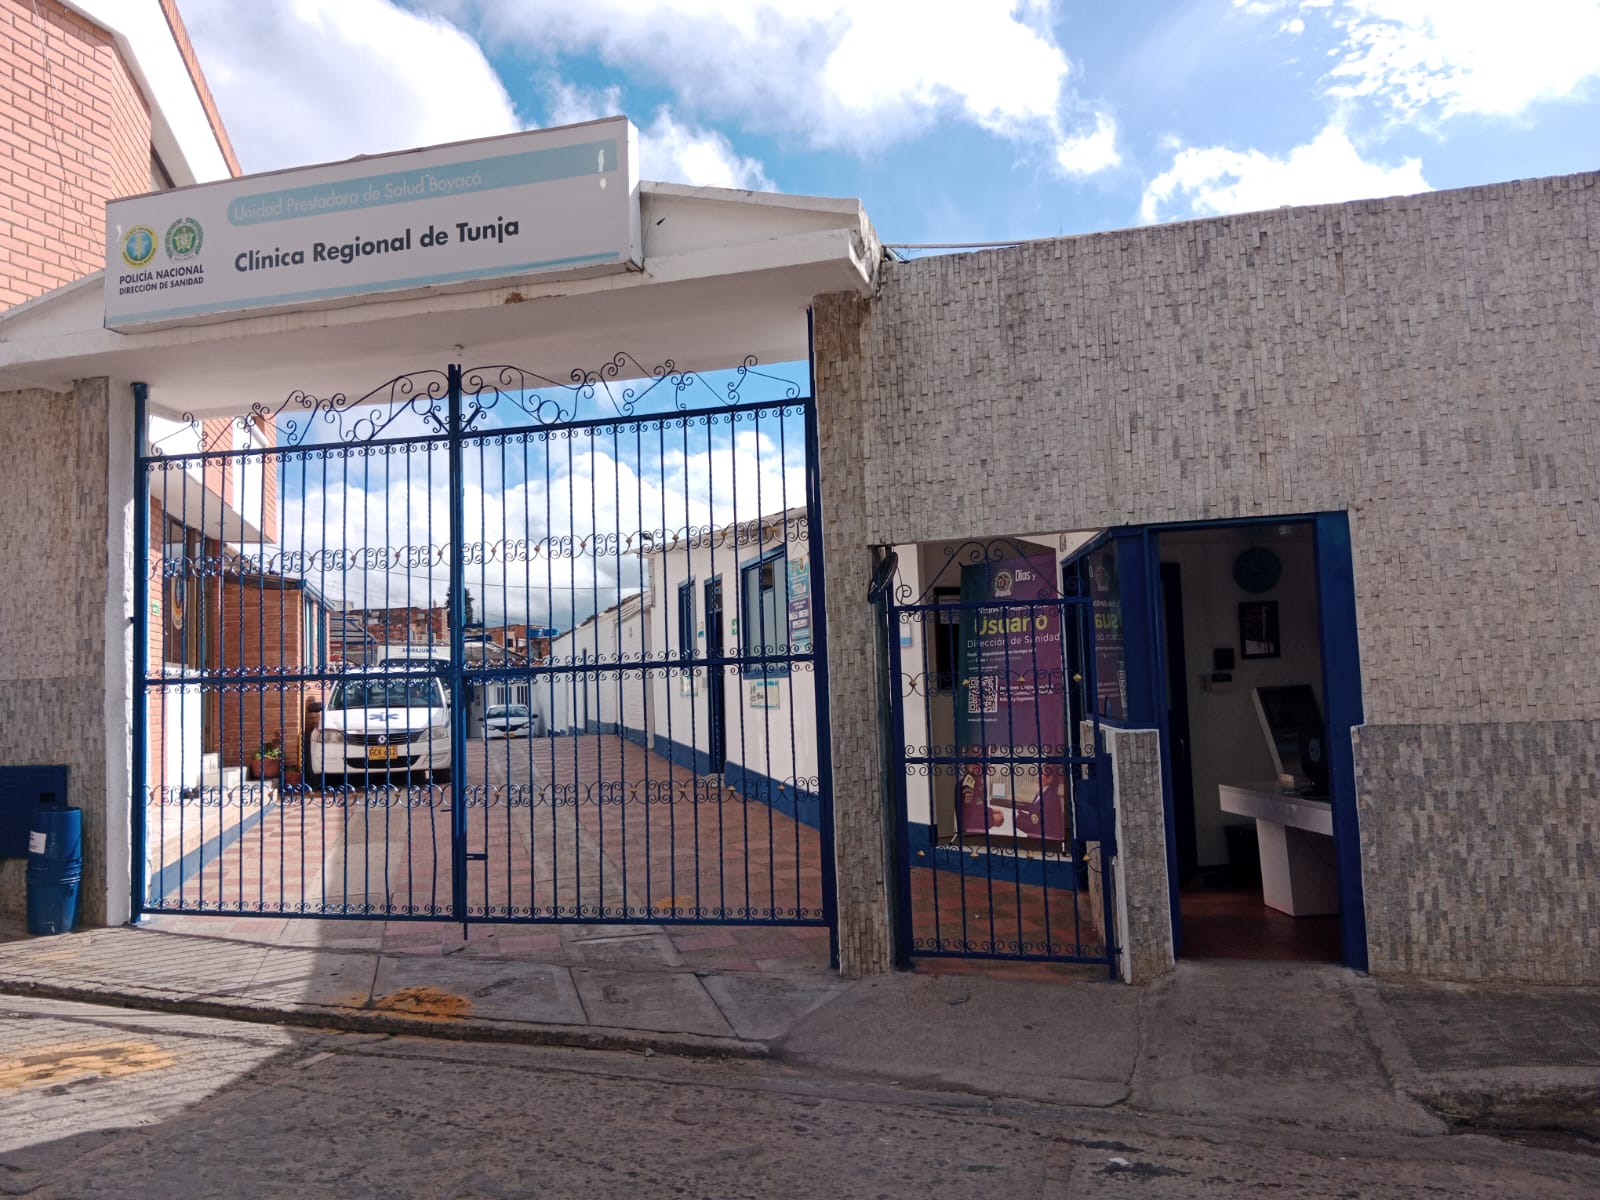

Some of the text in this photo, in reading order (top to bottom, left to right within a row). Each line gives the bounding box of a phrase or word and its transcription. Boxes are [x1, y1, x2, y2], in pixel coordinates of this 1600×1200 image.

[234, 170, 482, 220] Unidad Prestadora de Salud Boyacá
[234, 215, 519, 272] Clínica Regional de Tunja
[119, 264, 204, 285] POLICÍA NACIONAL
[160, 281, 168, 290] DE
[170, 277, 204, 288] SANIDAD
[974, 614, 1048, 636] Usuaro
[967, 637, 1005, 648] Diecció
[1011, 636, 1022, 645] de
